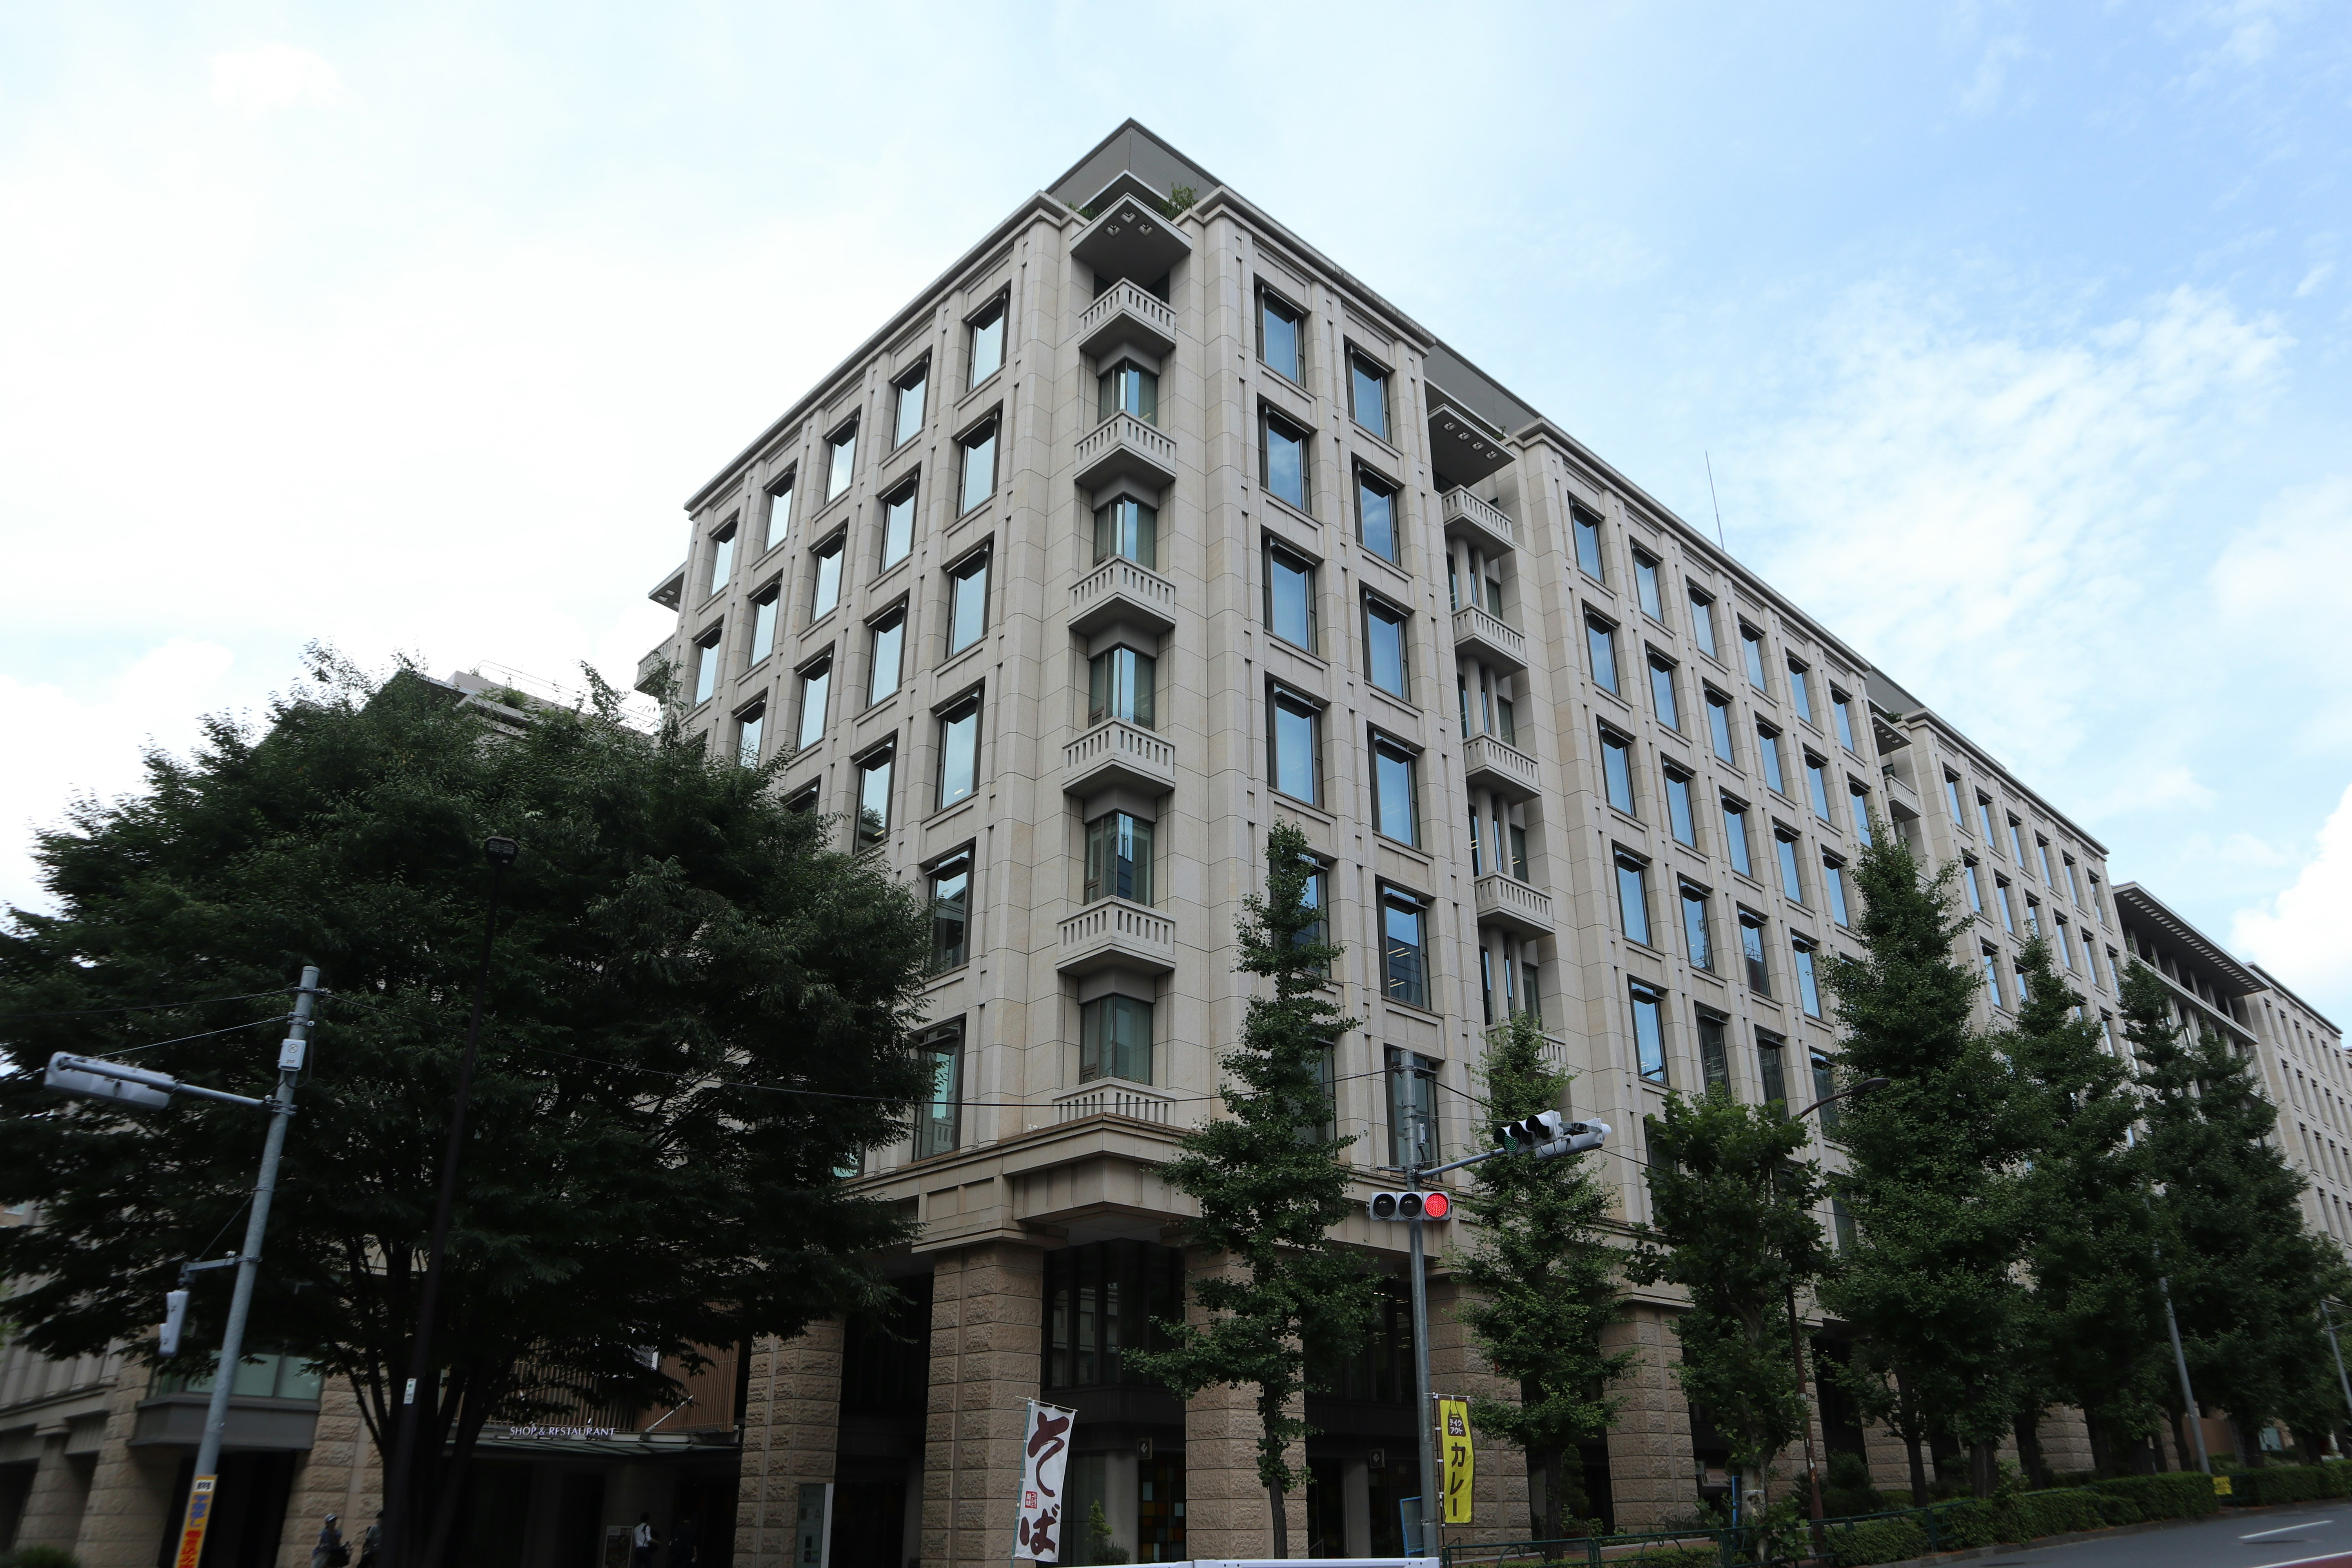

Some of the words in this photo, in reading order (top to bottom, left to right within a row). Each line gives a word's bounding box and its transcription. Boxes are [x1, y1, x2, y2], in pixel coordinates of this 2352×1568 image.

[510, 1426, 537, 1436] SHOP
[539, 1427, 546, 1436] &
[549, 1427, 615, 1436] RESTAURANT
[1020, 1411, 1069, 1555] そば
[1450, 1442, 1465, 1517] カレー
